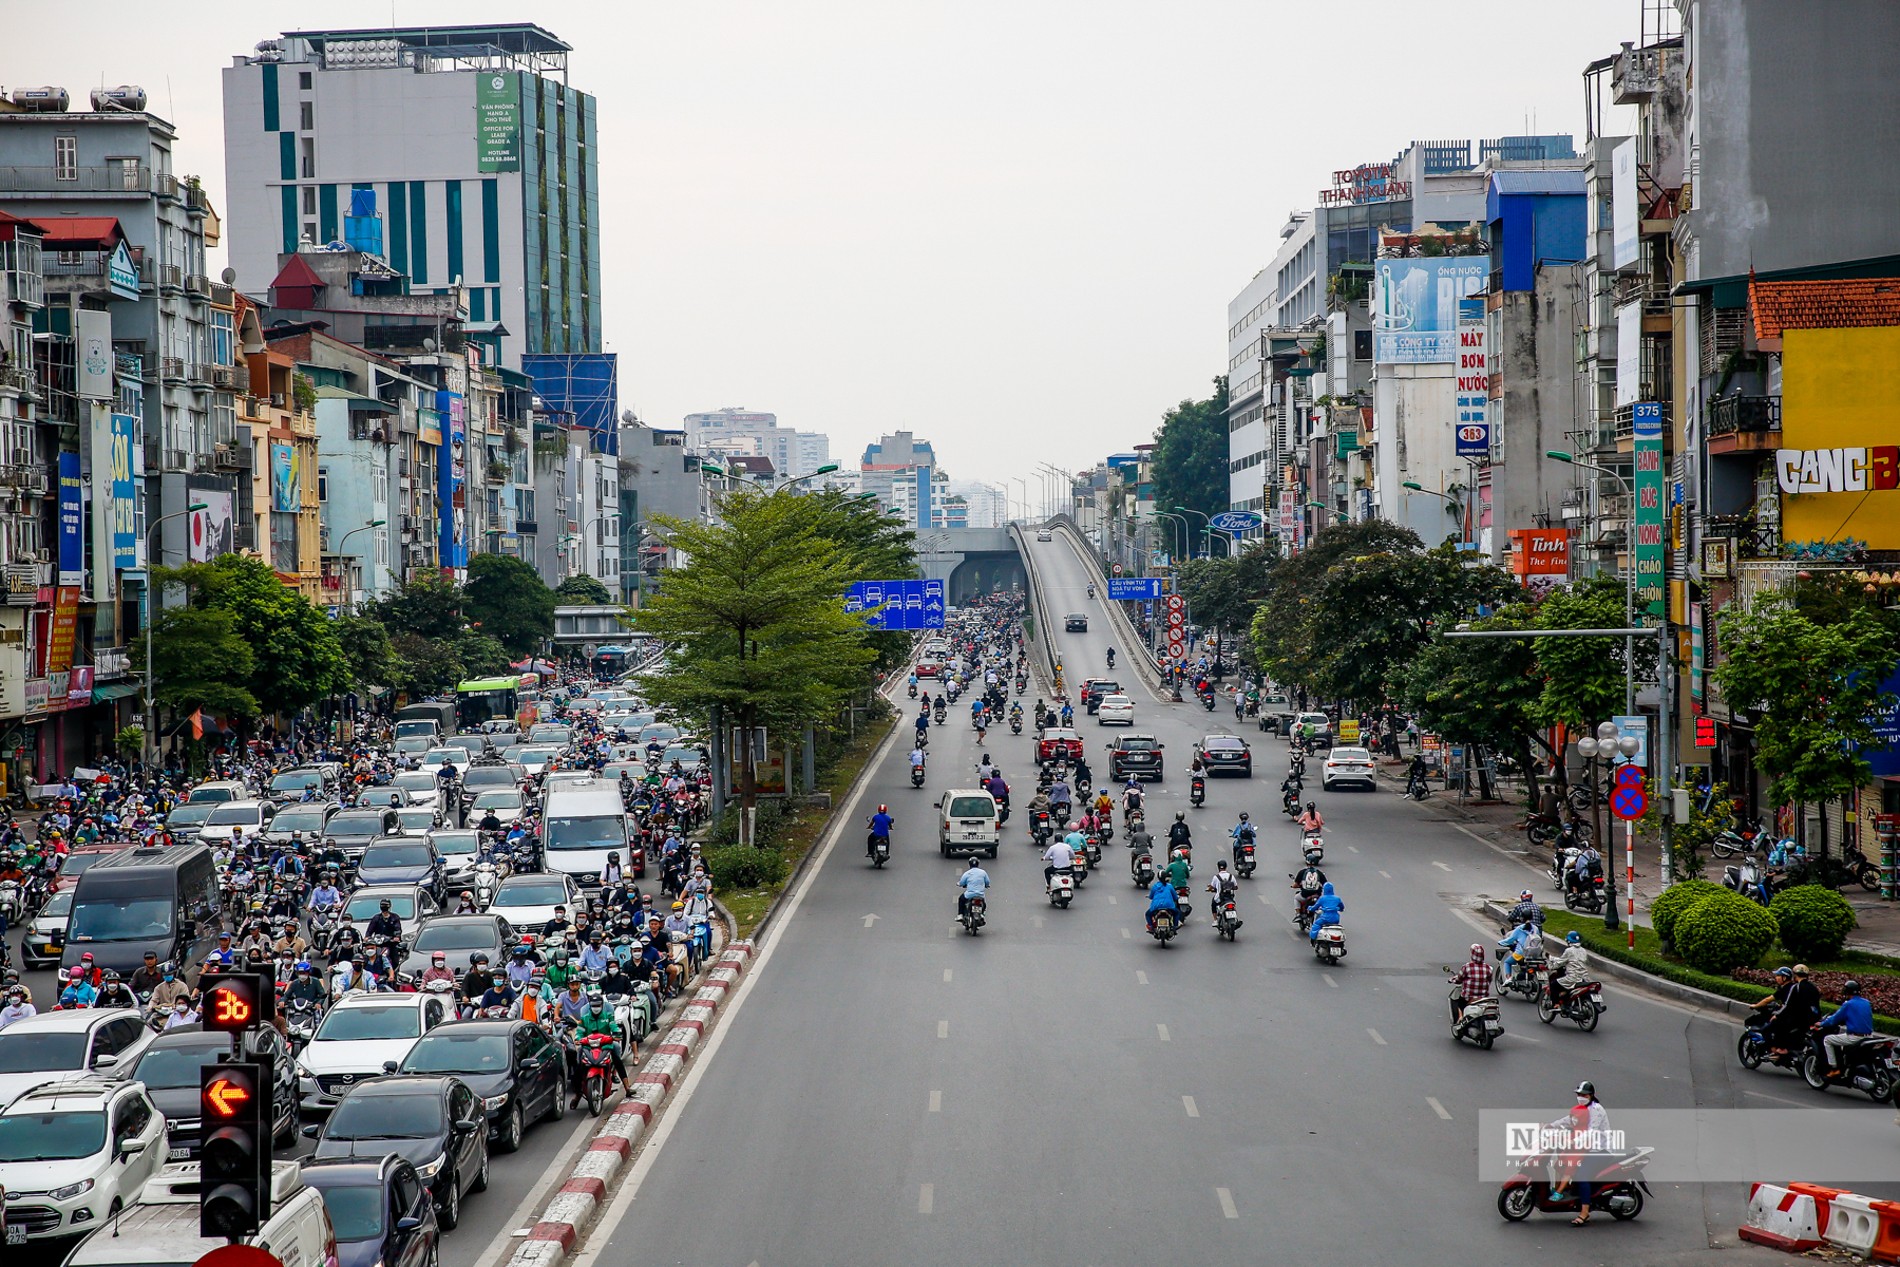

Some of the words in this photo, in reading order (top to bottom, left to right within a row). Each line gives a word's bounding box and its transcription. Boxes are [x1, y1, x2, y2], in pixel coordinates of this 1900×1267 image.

[1334, 166, 1390, 184] TOYOTA
[1322, 186, 1365, 202] THANH
[1438, 266, 1456, 274] ỐNG
[1458, 266, 1482, 274] NƯỚC
[1461, 328, 1483, 346] MÁY
[1462, 353, 1485, 368] BƠM
[1458, 372, 1488, 391] NƯỚC
[1637, 406, 1659, 416] 375
[1464, 428, 1482, 440] 363
[1637, 445, 1660, 472] BÁNH
[1776, 447, 1866, 494] GANG
[1640, 482, 1657, 509] ĐÚC
[1220, 514, 1252, 527] Ford
[1638, 520, 1661, 545] NÓNG
[1530, 557, 1546, 565] The
[1638, 554, 1661, 574] CHÁO
[1639, 582, 1662, 601] SƯỜN
[217, 988, 248, 1020] 36
